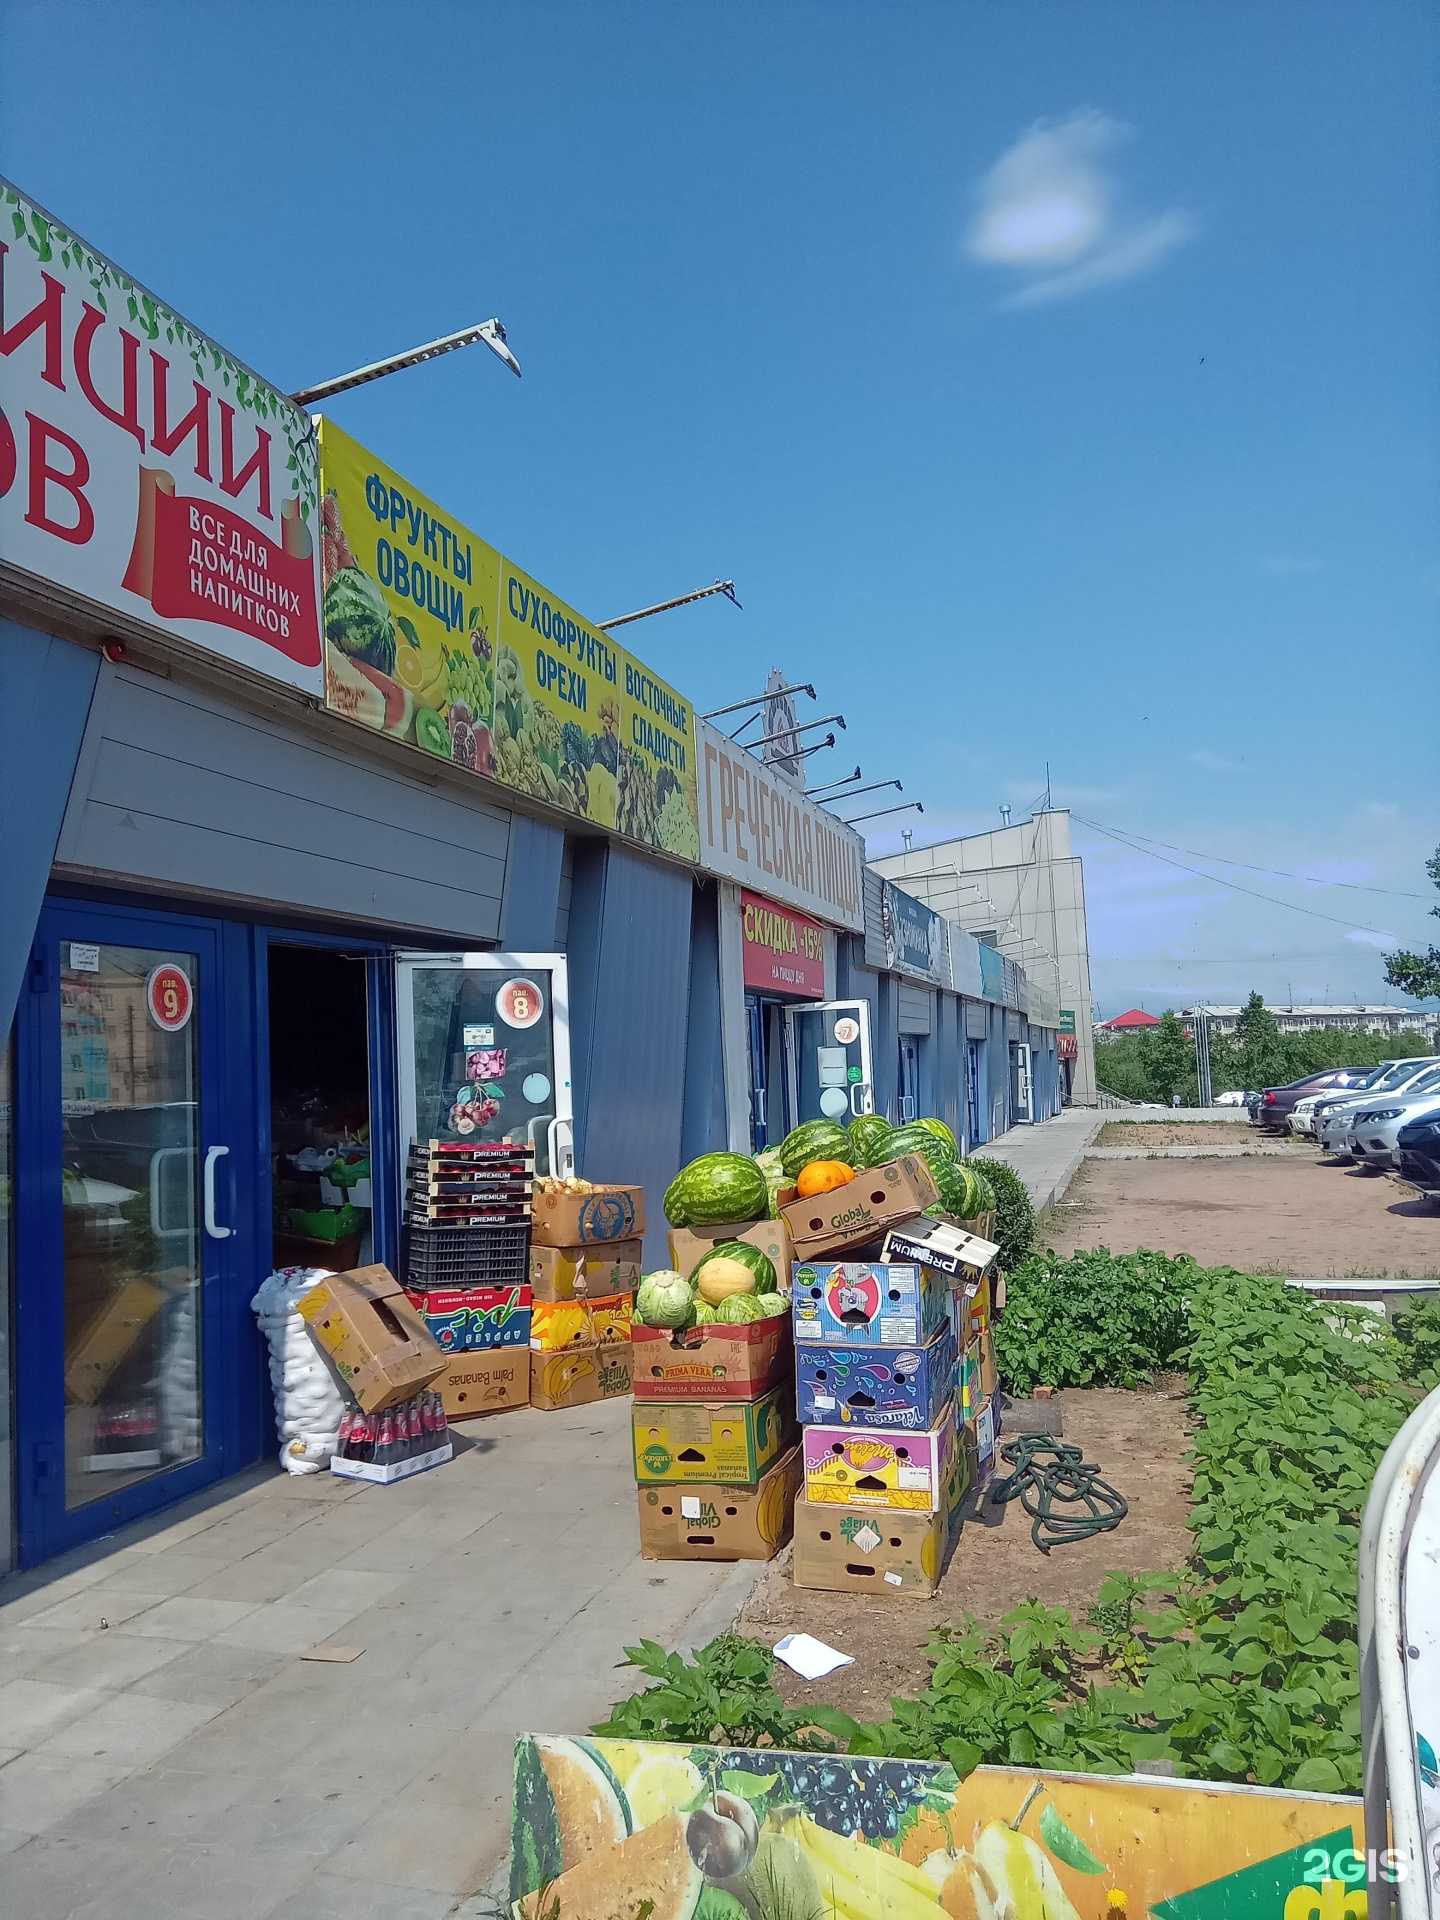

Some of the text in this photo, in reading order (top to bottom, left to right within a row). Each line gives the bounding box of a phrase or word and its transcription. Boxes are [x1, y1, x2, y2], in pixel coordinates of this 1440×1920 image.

[189, 505, 268, 570] ВСЕ ДЛЯ
[365, 473, 472, 586] ФРУКТЫ
[188, 538, 301, 617] ДОМАШНИХ
[376, 537, 465, 634] ОВОЩИ
[190, 568, 290, 638] НАПИТКОВ
[508, 577, 617, 685] СУХОФРУКТЫ
[536, 649, 587, 712] ОРЕХИ
[625, 662, 688, 735] ВОСТОЧНЫЕ
[632, 713, 686, 772] СЛАДОСТИ
[705, 742, 860, 922] ГРЕЧЕСКАЯ ПИЦЦА
[744, 904, 823, 962] СКИДКА -15%
[163, 989, 178, 1018] 9
[513, 996, 529, 1019] 8
[841, 1027, 850, 1038] 7
[473, 1151, 510, 1160] PREMIUM
[474, 1171, 511, 1181] PREMIUM
[471, 1194, 508, 1204] PREMIUM
[469, 1216, 506, 1225] PREMIUM
[831, 1203, 869, 1229] Global
[465, 1330, 521, 1344] APPLES
[449, 1368, 514, 1386] Palm Bananas
[598, 1364, 629, 1383] Village
[665, 1366, 712, 1378] PRIMA VERA
[600, 1377, 631, 1397] Global
[653, 1385, 727, 1393] PREMIUM BANANAS
[683, 1471, 749, 1480] Tropical Premium
[717, 1465, 748, 1473] Bananas
[687, 1516, 721, 1530] Global
